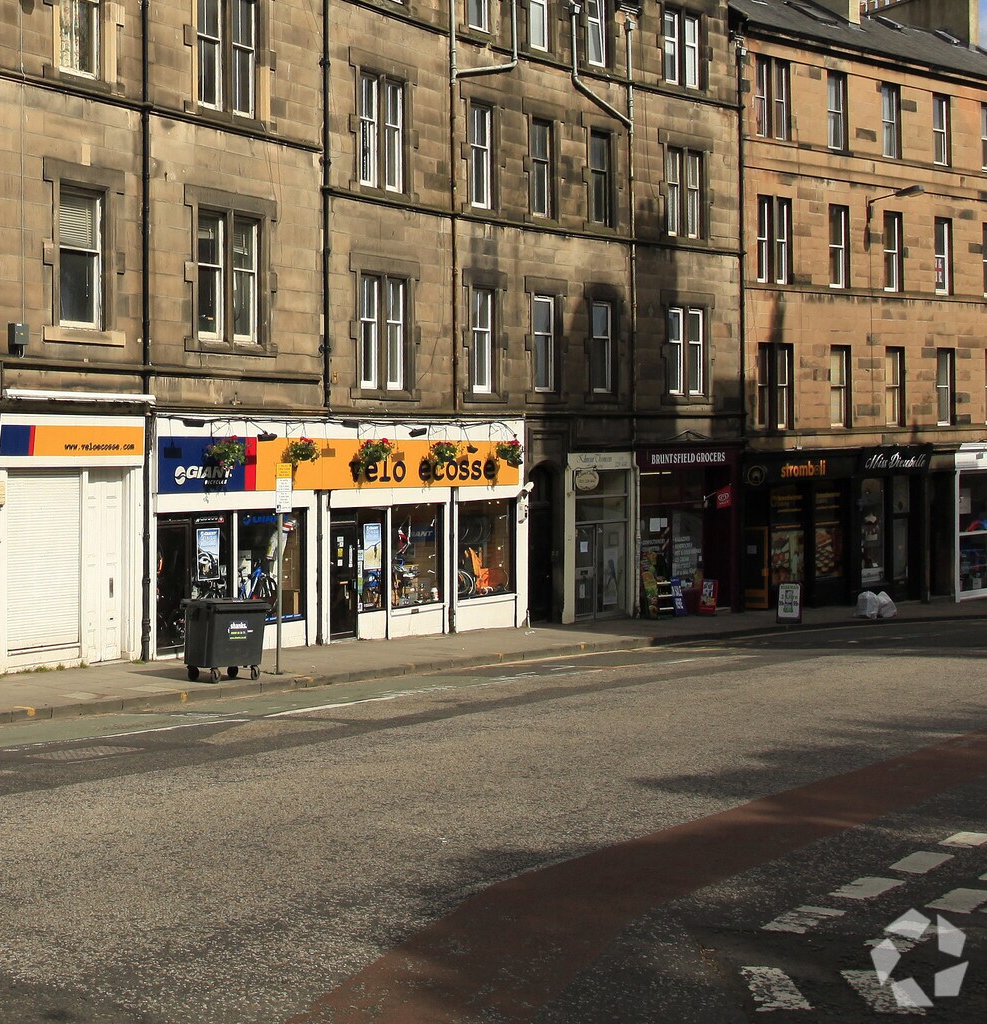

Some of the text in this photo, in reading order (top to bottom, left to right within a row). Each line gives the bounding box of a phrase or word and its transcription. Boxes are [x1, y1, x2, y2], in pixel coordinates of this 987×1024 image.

[64, 442, 135, 451] www.veloecosse.com
[651, 451, 726, 465] BRUNTSFIELD GROCERS
[864, 453, 888, 469] Miss
[186, 465, 233, 479] GIANT
[349, 455, 496, 483] velo ecosse
[781, 459, 826, 478] stromboli
